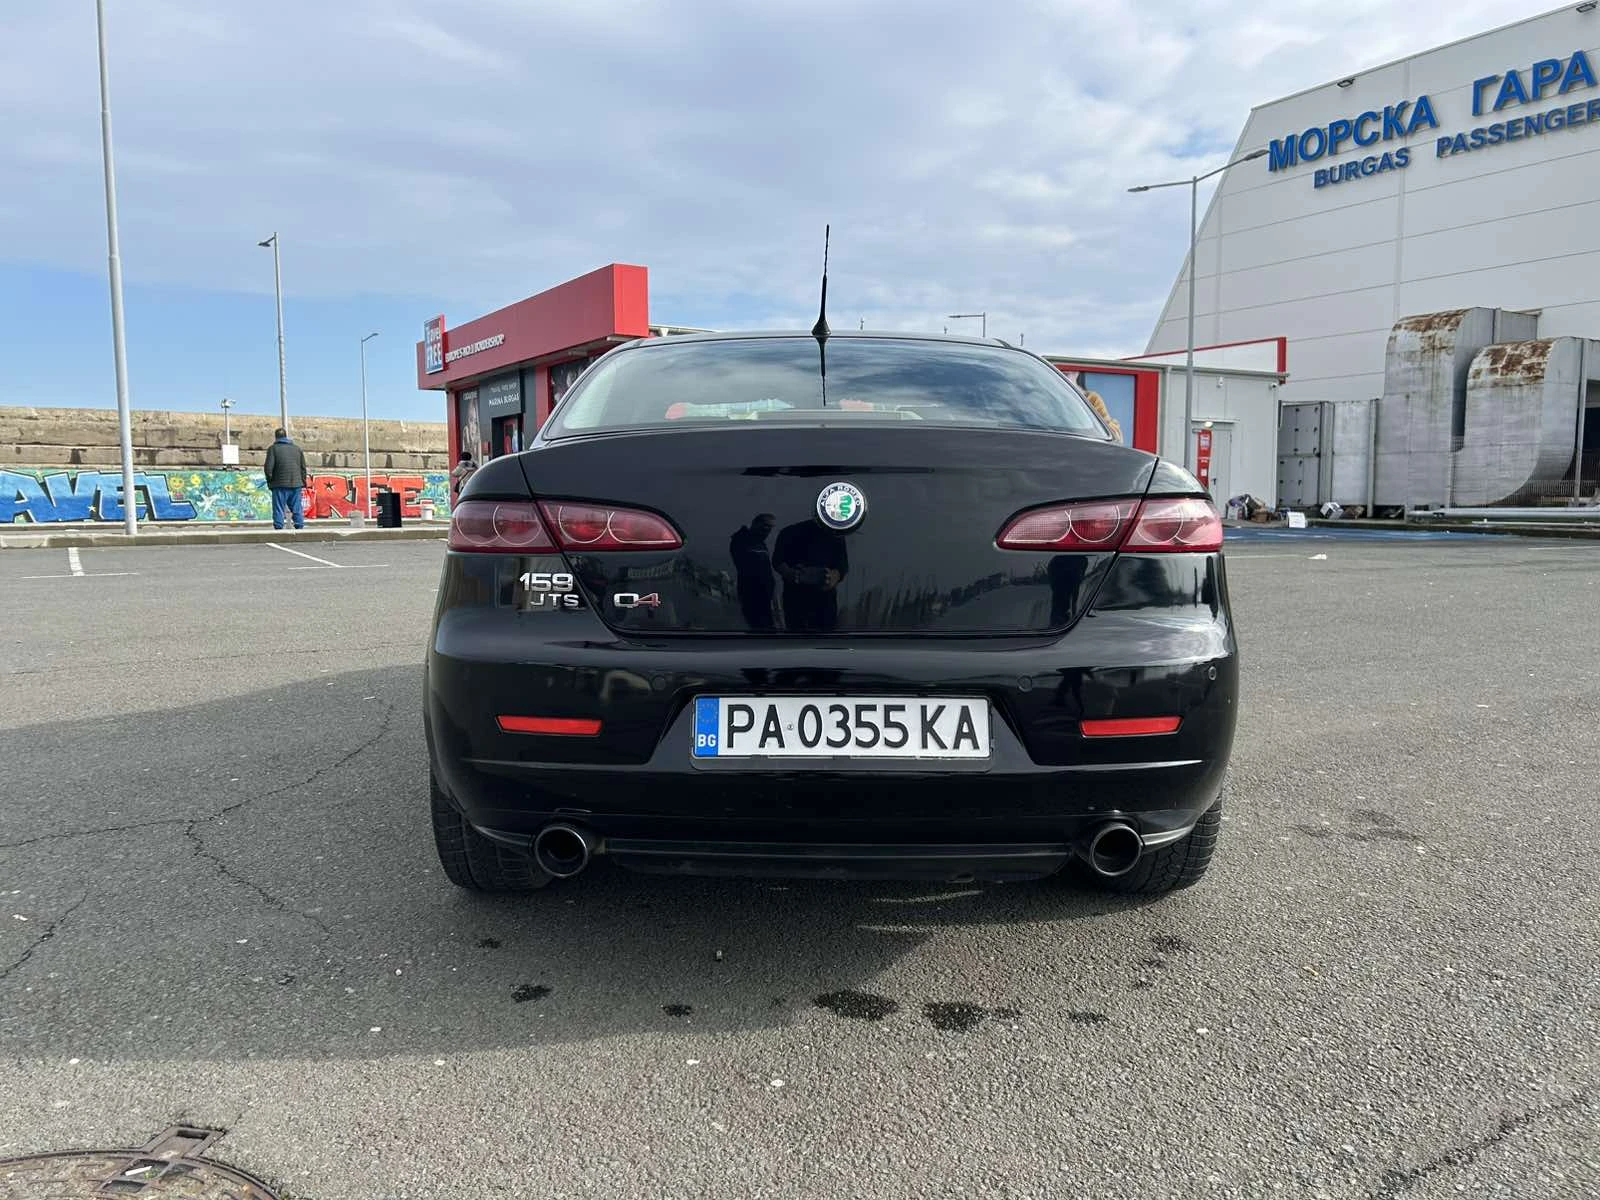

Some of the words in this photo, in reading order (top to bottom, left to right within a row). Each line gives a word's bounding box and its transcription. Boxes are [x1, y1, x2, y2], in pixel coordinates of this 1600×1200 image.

[1268, 95, 1440, 172] МОРСКА
[1471, 50, 1598, 116] ГАРА
[1313, 147, 1410, 189] BURGAS
[519, 572, 574, 592] 159
[530, 593, 579, 607] JTS
[613, 592, 661, 608] Q4
[726, 704, 785, 749] PA
[798, 704, 909, 749] 0355
[920, 705, 980, 750] KA
[697, 733, 716, 748] BG
